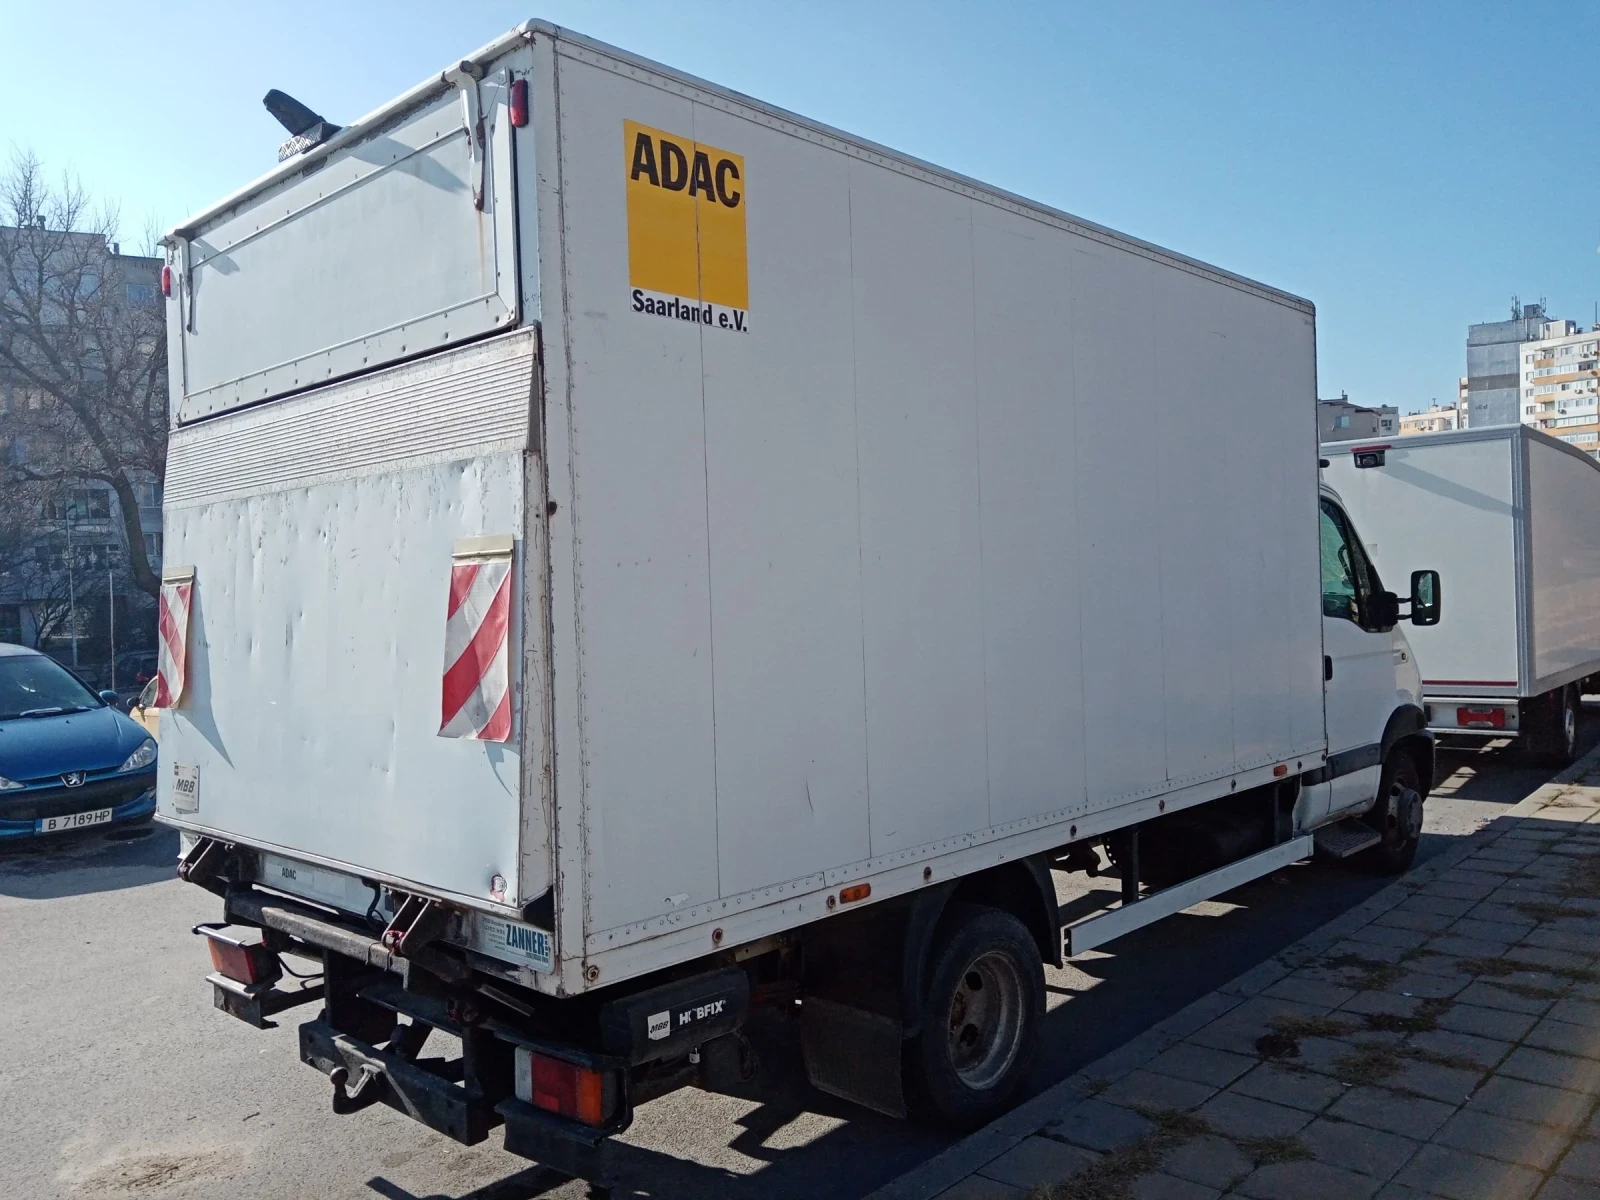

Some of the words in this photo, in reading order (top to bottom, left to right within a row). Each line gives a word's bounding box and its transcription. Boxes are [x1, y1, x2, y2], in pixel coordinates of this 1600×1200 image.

[631, 132, 741, 208] ADAC
[632, 289, 713, 325] Saarland
[719, 309, 748, 332] e.V.
[176, 779, 195, 793] MBB
[48, 819, 57, 830] B
[63, 813, 93, 829] 7189
[94, 810, 110, 823] HP
[281, 867, 297, 880] ADAC
[505, 923, 545, 956] ZANNER
[650, 1020, 669, 1034] MBB
